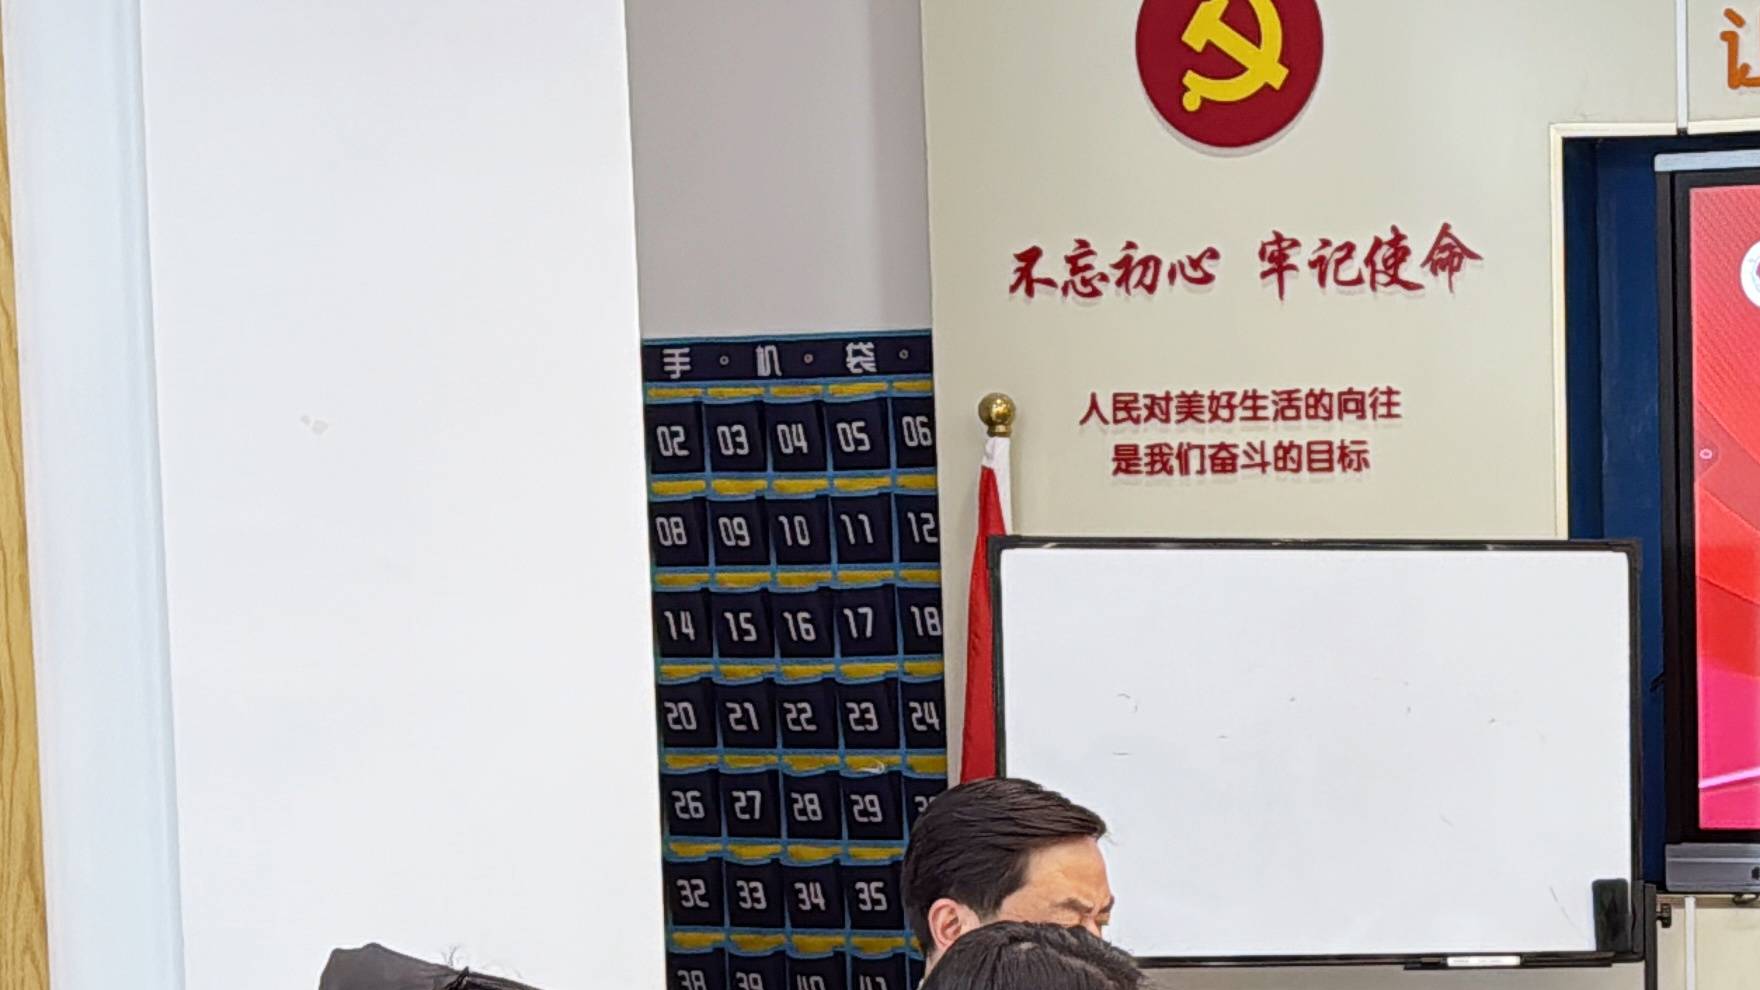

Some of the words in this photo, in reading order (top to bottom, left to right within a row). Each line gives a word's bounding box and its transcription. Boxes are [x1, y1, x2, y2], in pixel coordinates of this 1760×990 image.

[1009, 239, 1221, 300] 不忘初心
[1258, 222, 1484, 301] 牢记使命
[1079, 386, 1402, 426] 人民对美好生活的向往
[656, 426, 689, 457] 02
[717, 424, 749, 456] 03
[777, 423, 808, 454] 04
[837, 420, 870, 452] 05
[902, 416, 932, 447] 06
[1112, 438, 1370, 477] 是我们奋斗的目标
[655, 516, 687, 546] 08
[719, 517, 750, 546] 09
[778, 515, 810, 546] 10
[841, 513, 874, 544] 11
[908, 512, 938, 543] 12
[664, 610, 695, 640] 14
[724, 612, 757, 641] 15
[783, 612, 815, 641] 16
[843, 606, 873, 638] 17
[910, 606, 942, 636] 18
[665, 702, 697, 730] 20
[727, 703, 760, 731] 21
[783, 703, 817, 731] 22
[846, 702, 878, 731] 23
[909, 702, 940, 731] 24
[672, 791, 705, 819] 26
[732, 791, 762, 820] 27
[791, 793, 823, 821] 28
[850, 794, 883, 823] 29
[677, 879, 709, 908] 32
[737, 881, 767, 909] 33
[794, 882, 825, 910] 34
[856, 882, 887, 911] 35
